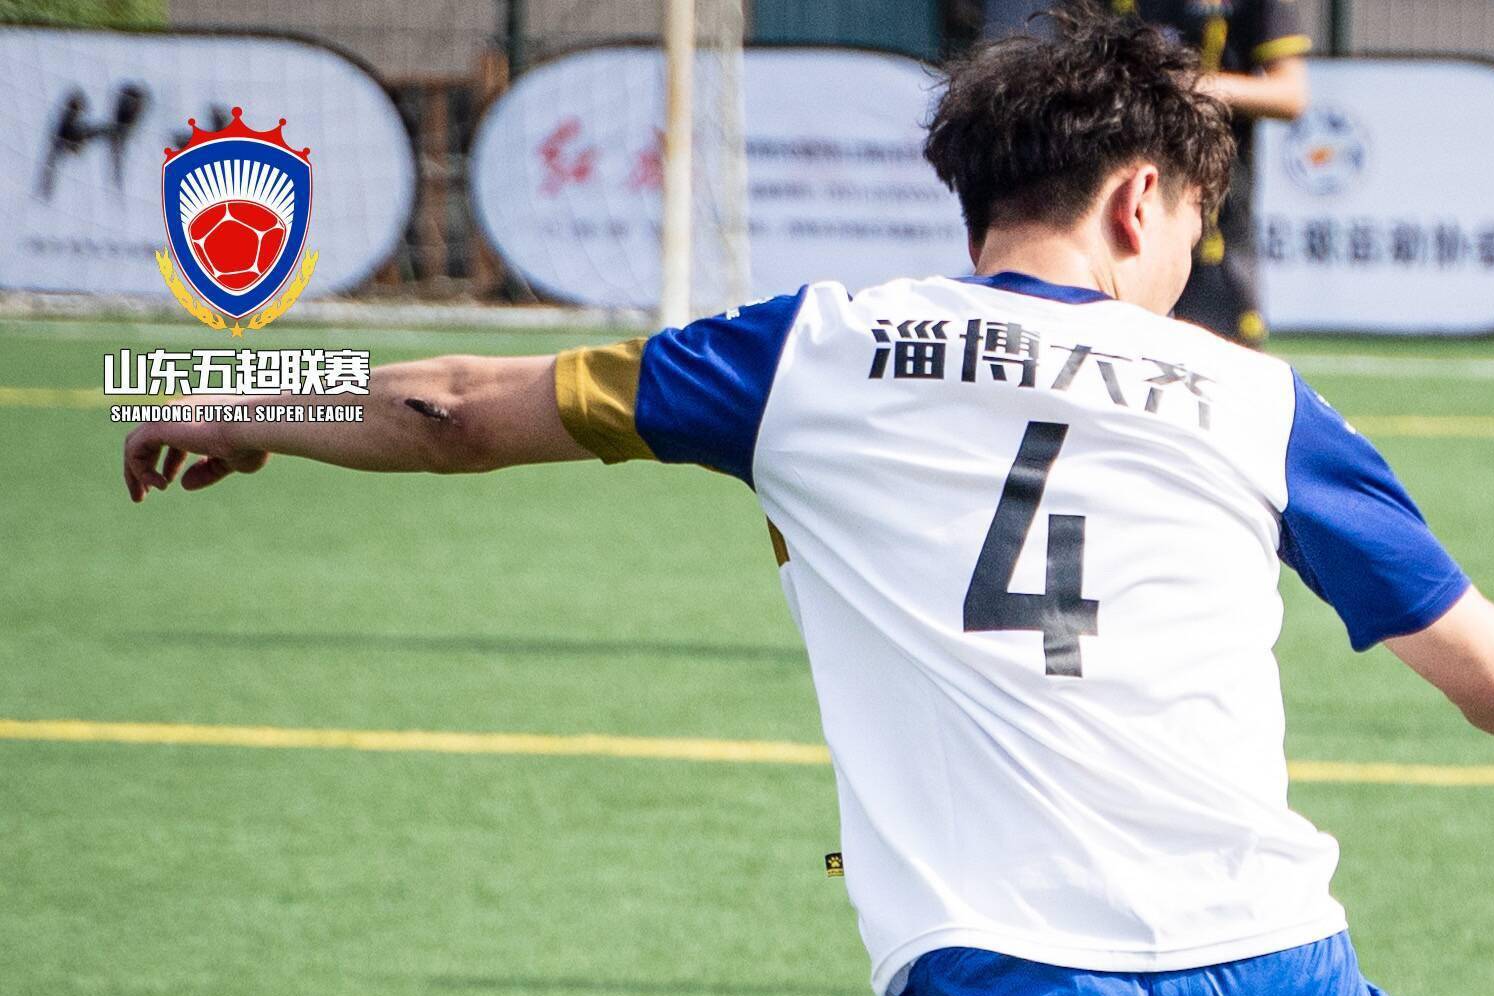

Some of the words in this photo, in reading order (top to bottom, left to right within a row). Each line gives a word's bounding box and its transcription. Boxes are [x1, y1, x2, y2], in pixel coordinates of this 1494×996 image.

[868, 318, 1217, 431] 淄博大齐
[963, 421, 1099, 678] 4
